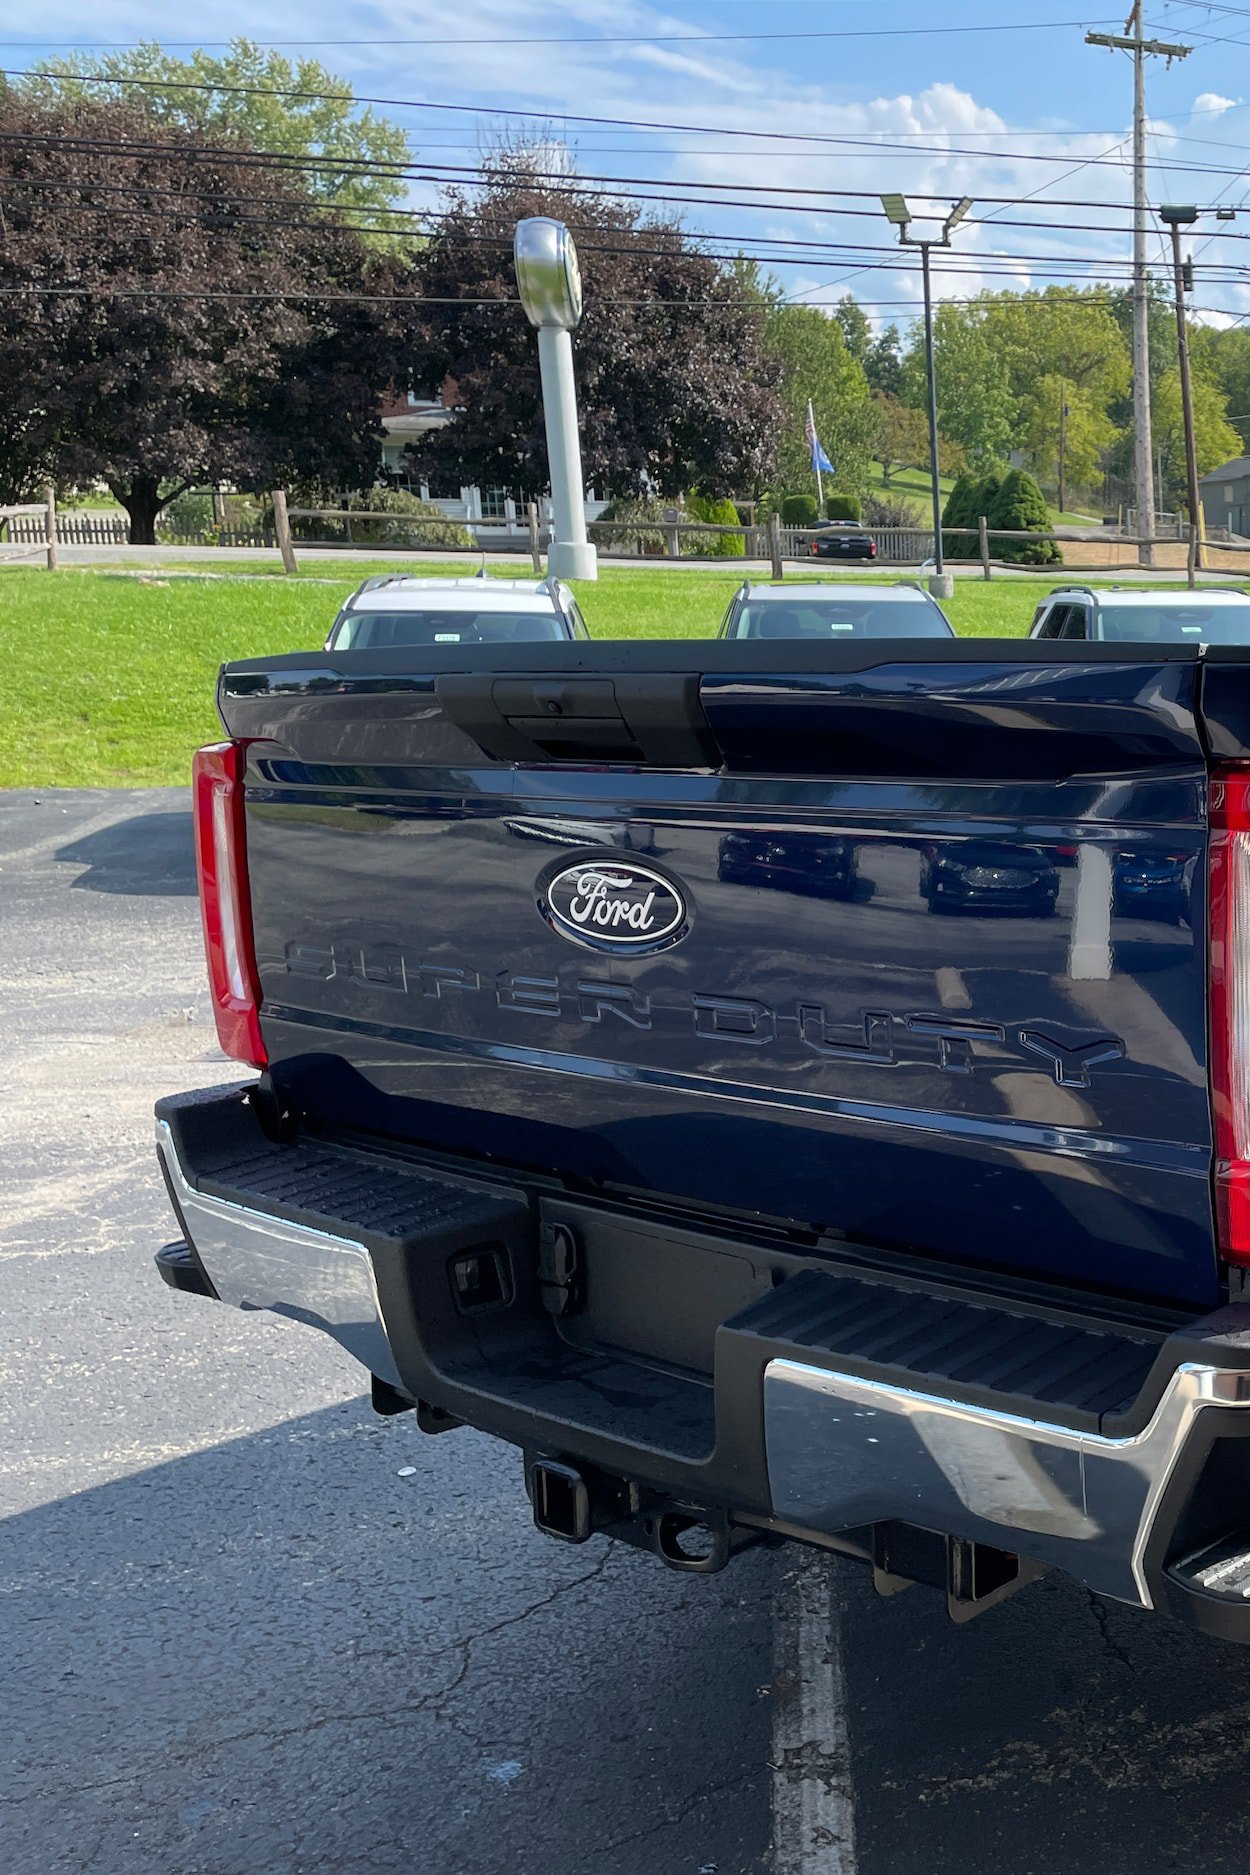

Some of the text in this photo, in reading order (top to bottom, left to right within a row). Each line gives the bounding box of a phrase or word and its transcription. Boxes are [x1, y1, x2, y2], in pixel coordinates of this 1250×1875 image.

[570, 872, 656, 930] Ford
[285, 940, 1125, 1090] SUPER DUTY
